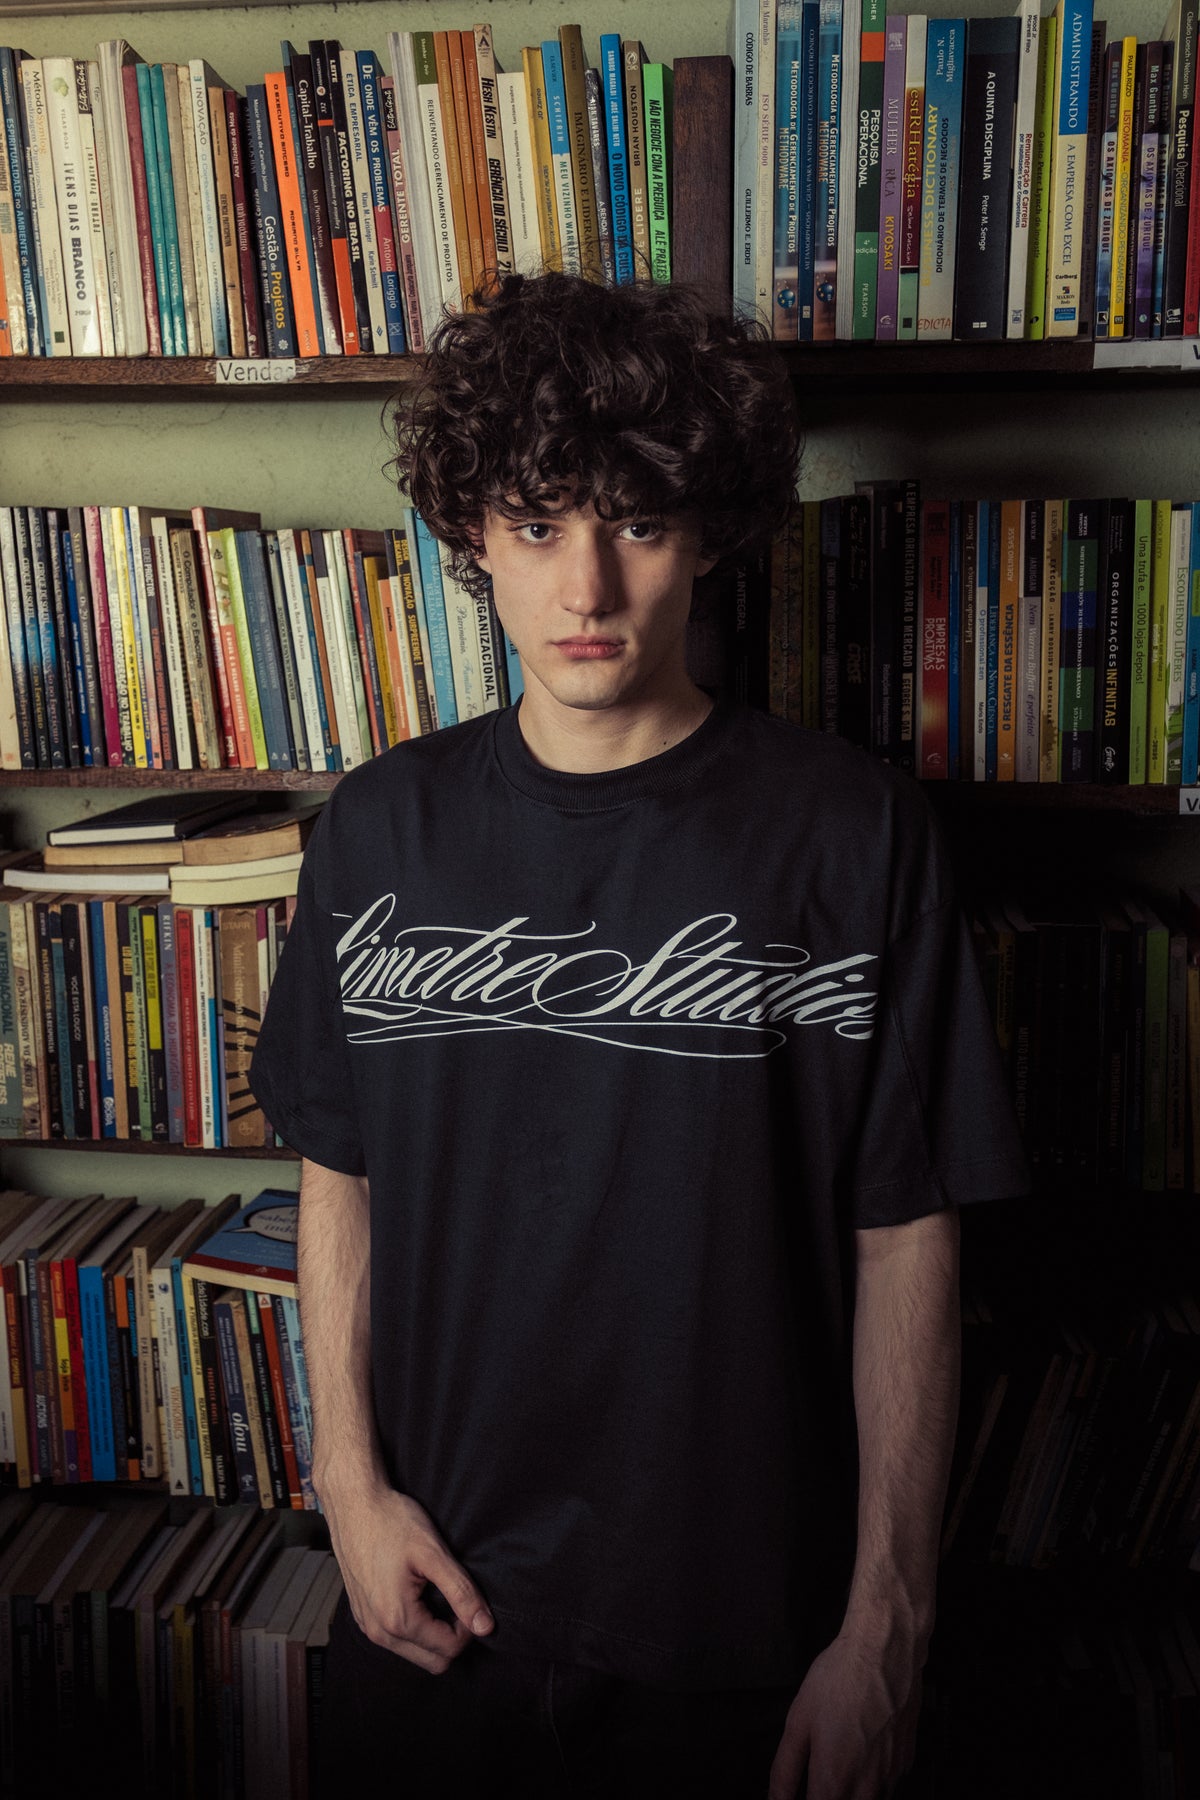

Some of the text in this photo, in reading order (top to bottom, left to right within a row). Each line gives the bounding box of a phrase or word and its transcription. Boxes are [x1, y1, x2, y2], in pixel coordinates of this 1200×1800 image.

[745, 32, 755, 106] CÓDIGO DE BARRAS
[945, 28, 956, 83] Migliavacca
[1068, 12, 1082, 128] ADMINISTRANDO
[32, 71, 44, 114] Método
[196, 87, 208, 145] INOVAÇÃO
[346, 73, 363, 162] ÉTICA EMPRESARIAL
[365, 84, 377, 111] ONDE
[481, 78, 497, 138] HESH KESTIN
[552, 95, 564, 142] SCHIFRIN
[649, 100, 662, 116] NÃO
[985, 81, 996, 120] QUINTA
[368, 115, 381, 136] VÊM
[370, 140, 381, 153] OS
[573, 112, 589, 185] IMAGINÁRIO
[630, 85, 640, 166] BRIAN HOUSTON
[650, 118, 662, 151] NEGOCIE
[818, 120, 829, 182] METHODWARE
[858, 110, 870, 187] OPERACIONAL
[869, 110, 880, 165] PESQUISA
[885, 98, 898, 198] MULHER RICA
[982, 124, 994, 179] DISCIPLINA
[372, 157, 386, 212] PROBLEMAS
[652, 154, 663, 172] COM
[778, 127, 789, 189] METHODWARE
[1172, 110, 1190, 206] Pesquisa Operacional
[337, 132, 360, 262] FACTORING NO BRASIL
[391, 150, 410, 243] GERENTE TOTAL
[426, 100, 453, 282] REINVENTANDO GERENCIAMENTO DE PROJETOS
[560, 162, 576, 256] MEU VIZINHO WARREN
[634, 188, 644, 235] LIDERE
[652, 182, 664, 220] PREGUIÇA
[922, 104, 938, 286] BUSINESS DICTIONARY
[935, 118, 948, 272] DICIONÁRIO DE TERMOS DE NEGÓCIOS
[1062, 144, 1076, 266] A EMPRESA COM EXCEL
[1102, 141, 1116, 254] OS AXIOMAS DE ZURIQUE
[1142, 148, 1155, 252] OS AXIOMAS DE ZURIQUE
[64, 163, 87, 300] IVENS DIAS BRANCO
[311, 190, 326, 248] Jean Pierre Marras
[884, 215, 895, 270] KIYOSAKI
[265, 216, 286, 329] Gestão de Projetos
[384, 238, 398, 308] Antonio Loriggio
[904, 492, 915, 534] EMPRESA
[73, 532, 82, 563] SLATER
[142, 547, 154, 596] BOB PROCTOR
[904, 538, 915, 588] ORIENTADA
[110, 592, 122, 627] ESPÍRITO
[183, 560, 198, 610] Computador
[191, 629, 203, 668] Executivo
[400, 573, 422, 666] INOVAÇÃO SURPREENDE!
[903, 590, 914, 613] PARA
[1176, 567, 1187, 636] ESCOLHENDO
[114, 630, 123, 641] DE
[476, 599, 495, 700] RGANIZACIONAL
[902, 626, 913, 668] MERCADO
[924, 617, 936, 671] PROATIVAS
[936, 617, 946, 671] EMPRESAS
[1004, 604, 1014, 655] ESSÊNCIA
[1104, 572, 1120, 726] ORGANIZAÇÕES INFINITAS
[115, 642, 127, 694] COOPERAÇÃO
[987, 605, 998, 734] LIDERANÇA NOVA CIÊNCIA
[1003, 658, 1013, 672] DA
[120, 696, 129, 709] NO
[1003, 675, 1012, 720] RESGATE
[121, 710, 132, 751] TRABALHO
[162, 915, 173, 951] RIFKIN
[2, 942, 13, 1034] INTERNACIONAL
[165, 972, 176, 1018] ECONOMIA
[231, 942, 247, 1014] Administração
[532, 913, 878, 1041] Studios
[168, 1022, 177, 1034] DO
[236, 1031, 248, 1078] Produção
[4, 1043, 15, 1078] RENE
[169, 1038, 180, 1092] HIDROGÊNIO
[36, 1394, 48, 1429] AUCTIONS
[171, 1386, 183, 1440] WIKINOMICS
[232, 1412, 250, 1452] mojo
